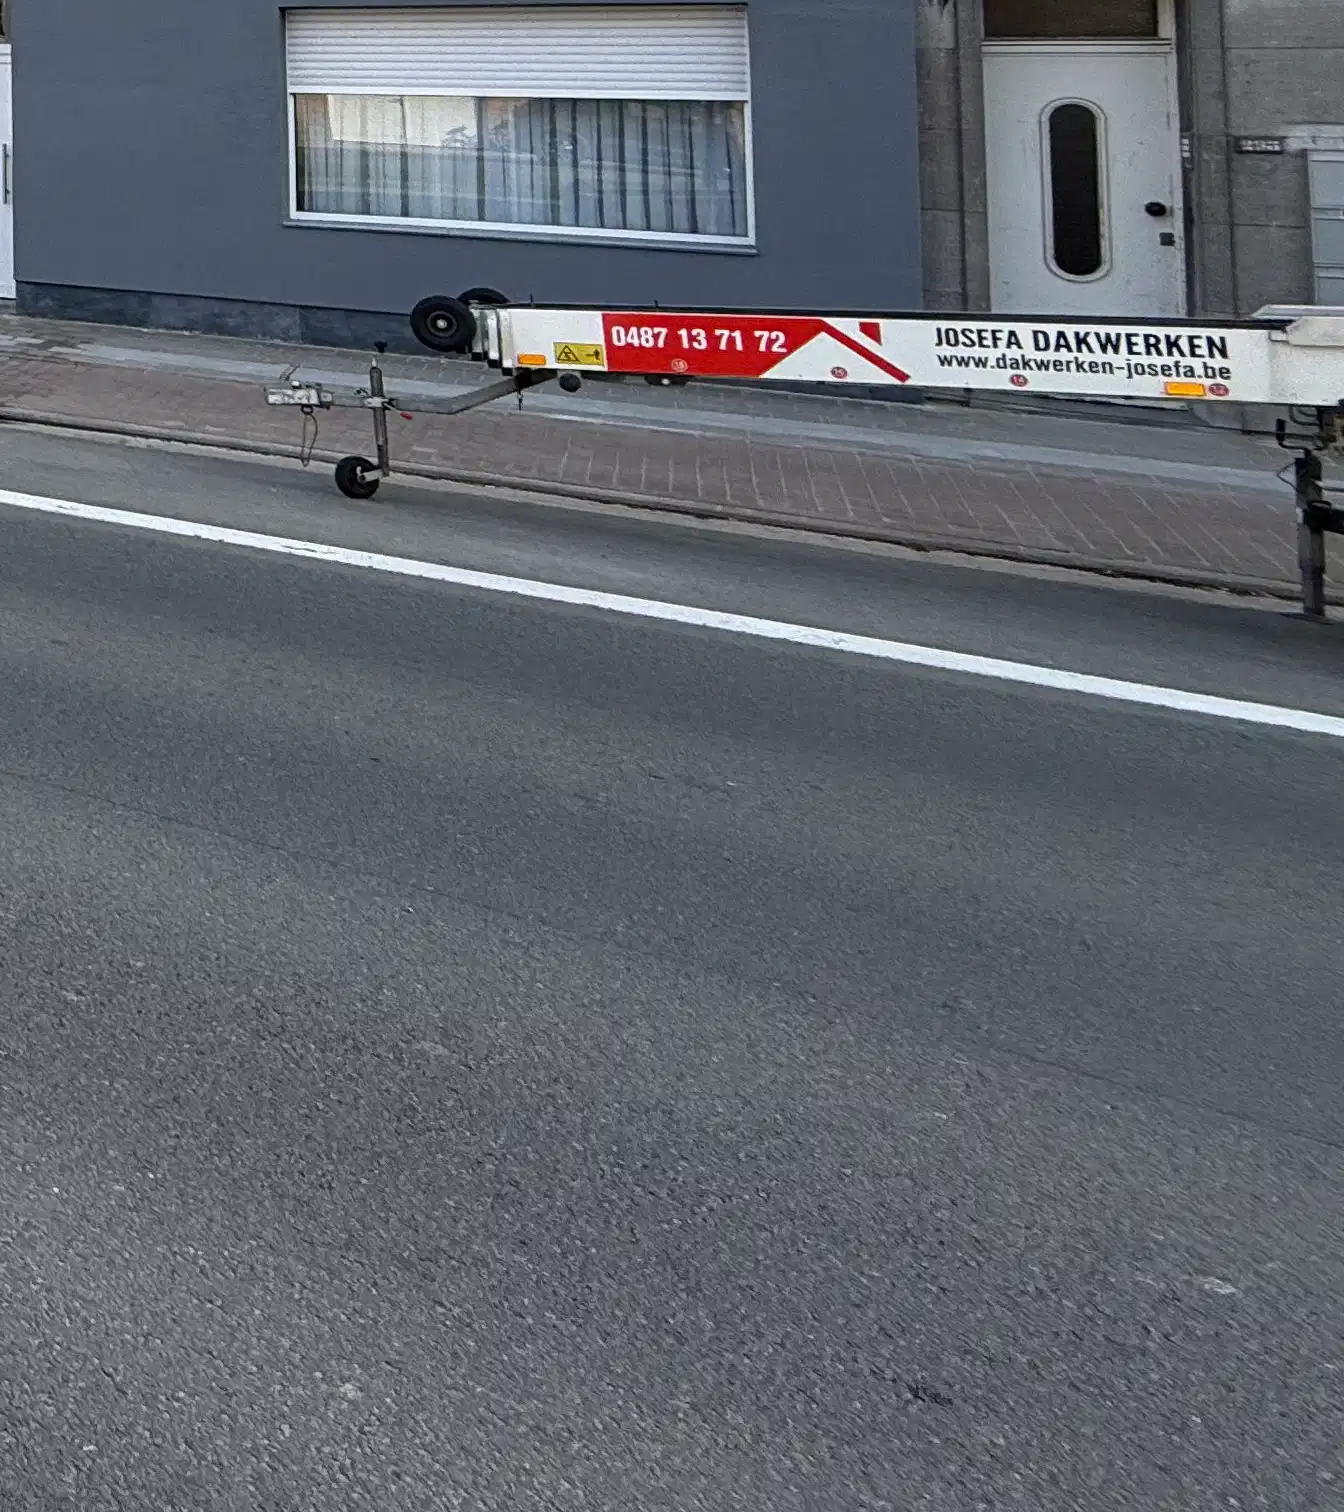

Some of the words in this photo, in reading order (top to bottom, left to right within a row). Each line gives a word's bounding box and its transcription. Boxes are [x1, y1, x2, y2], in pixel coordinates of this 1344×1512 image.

[612, 325, 668, 348] 0487
[677, 327, 708, 350] 13
[714, 329, 744, 352] 71
[753, 330, 788, 353] 72
[935, 327, 1023, 350] JOSEFA
[1032, 329, 1229, 359] DAKWERKEN
[936, 353, 1232, 381] www.dakwerken-josefa.be
